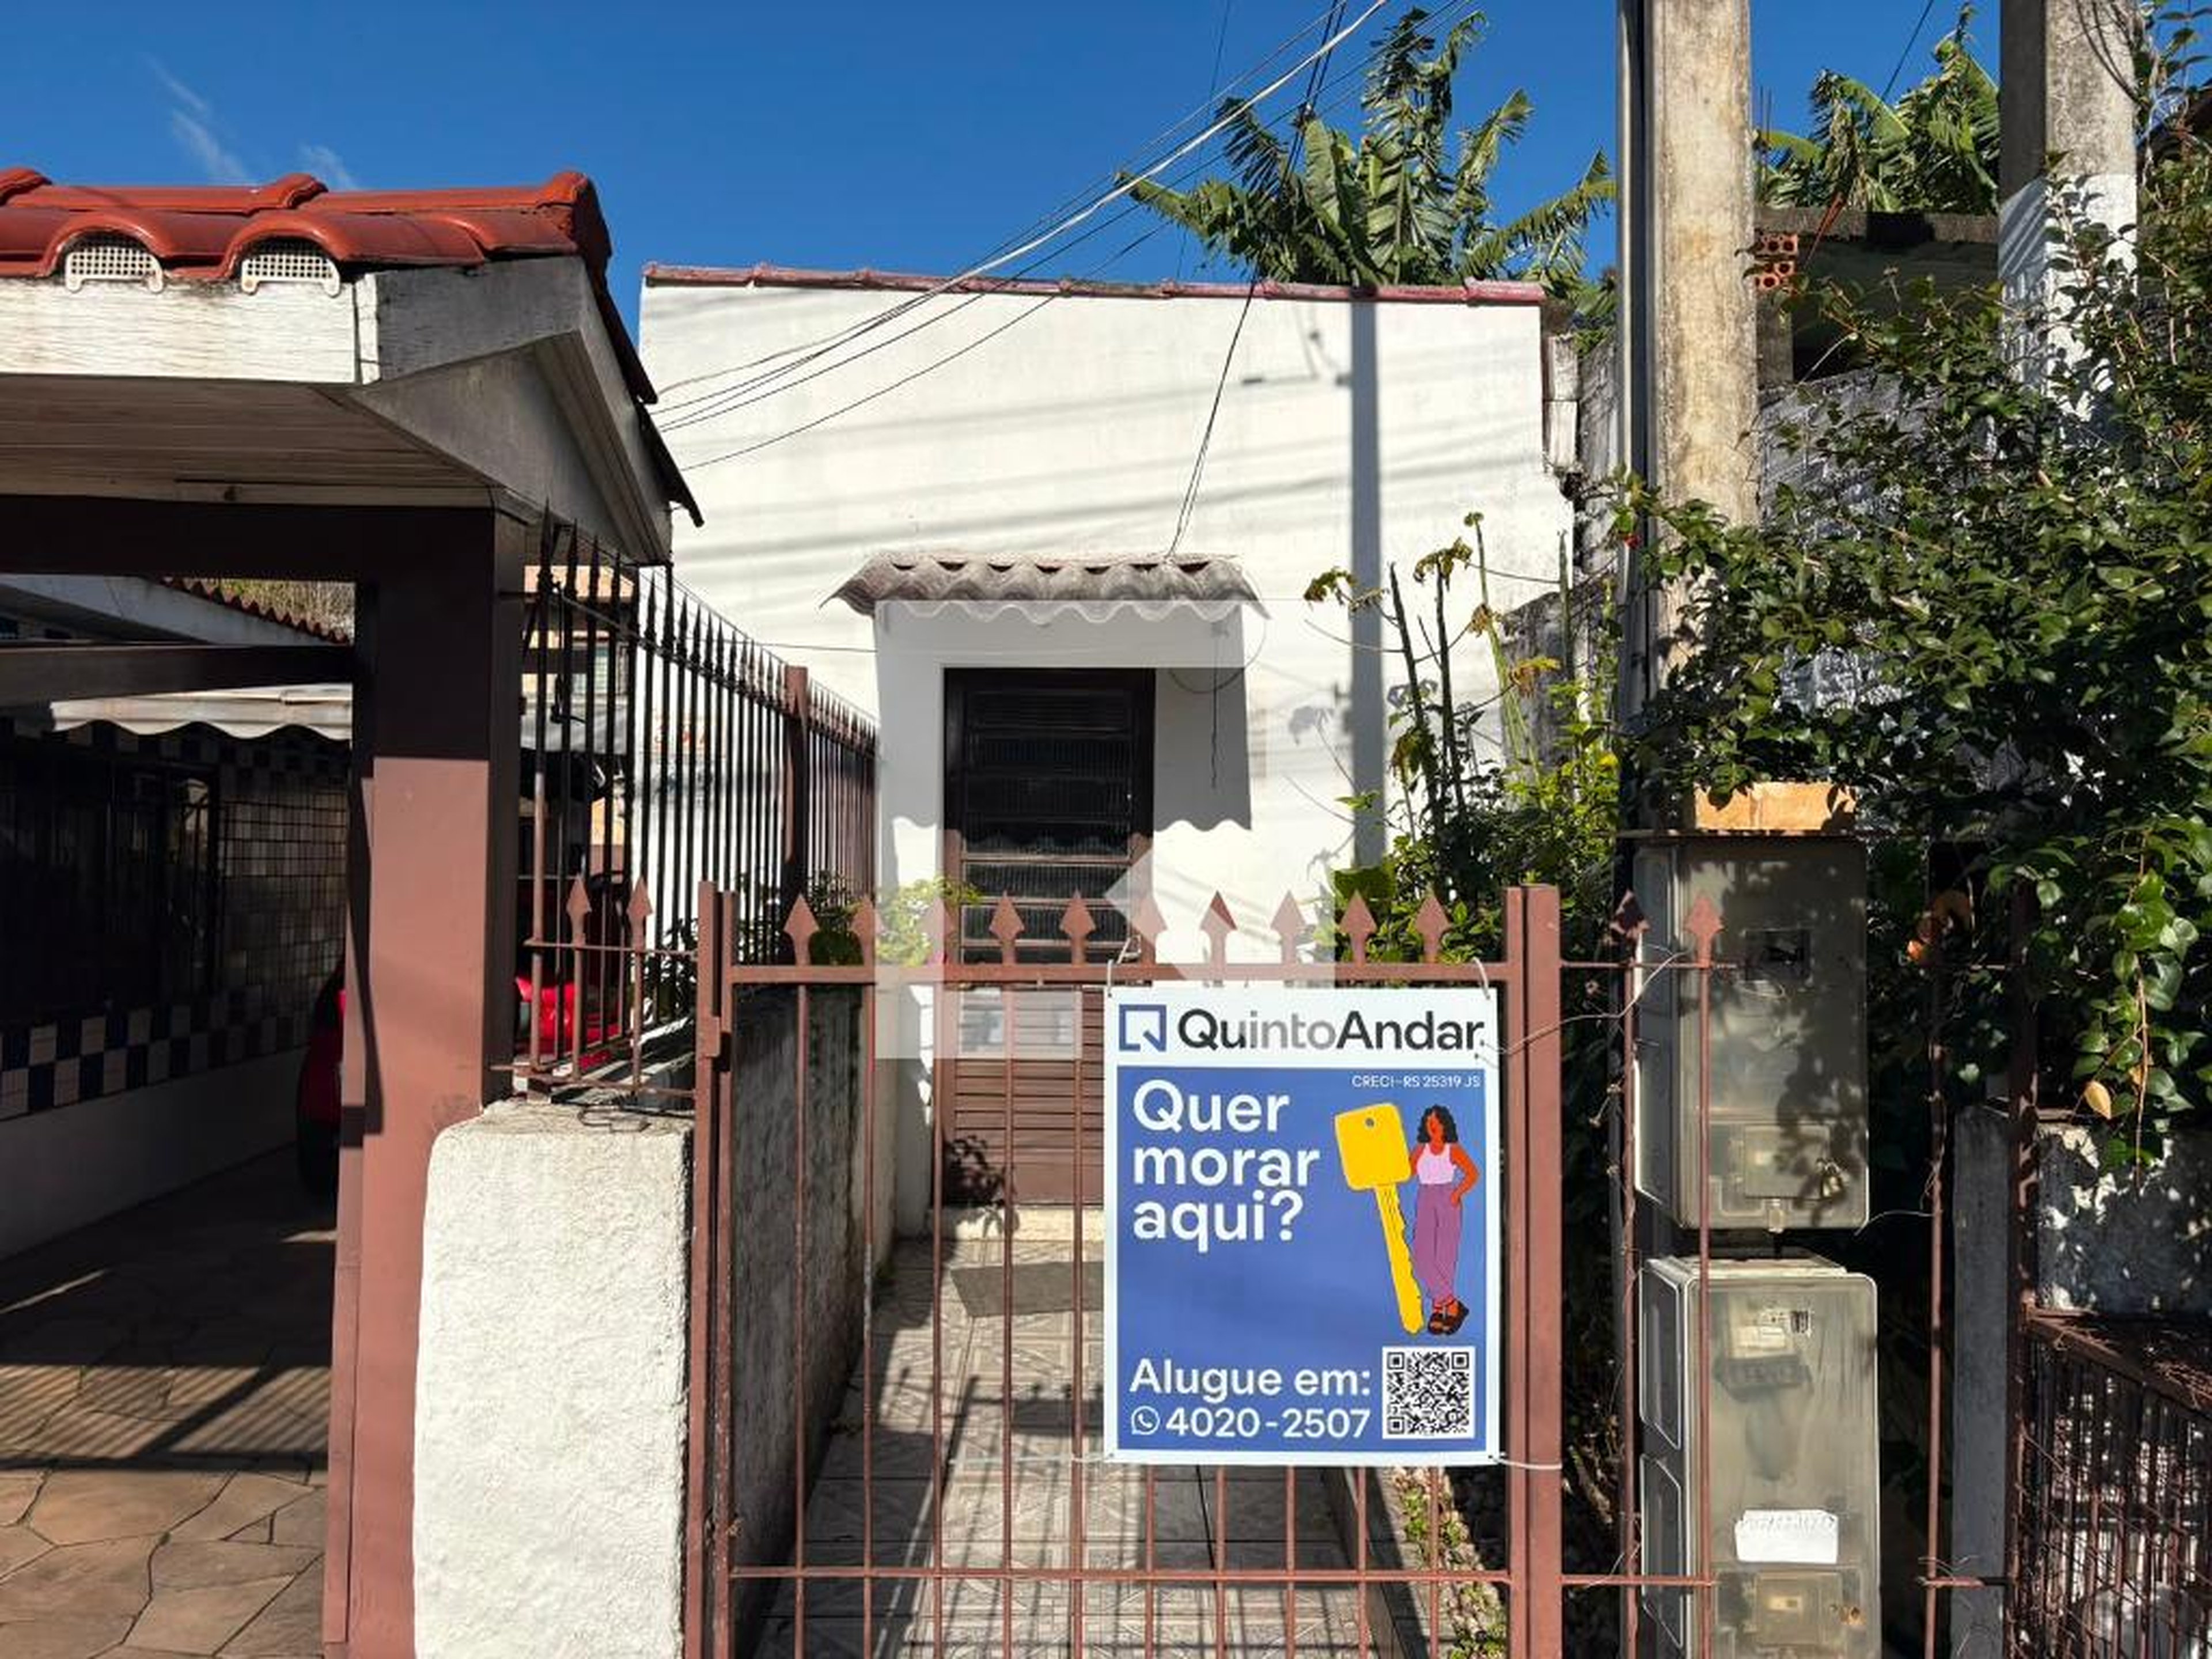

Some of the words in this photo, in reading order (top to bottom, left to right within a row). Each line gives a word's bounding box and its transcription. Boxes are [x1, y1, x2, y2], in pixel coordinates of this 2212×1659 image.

[1177, 1008, 1484, 1051] QuintoAndar
[1422, 1075, 1462, 1088] 25319
[1464, 1075, 1480, 1088] JS
[1133, 1079, 1290, 1133] Quer
[1134, 1147, 1321, 1187] morar
[1133, 1190, 1304, 1253] aqui?
[1129, 1358, 1282, 1404] Alugue
[1294, 1368, 1372, 1397] em:
